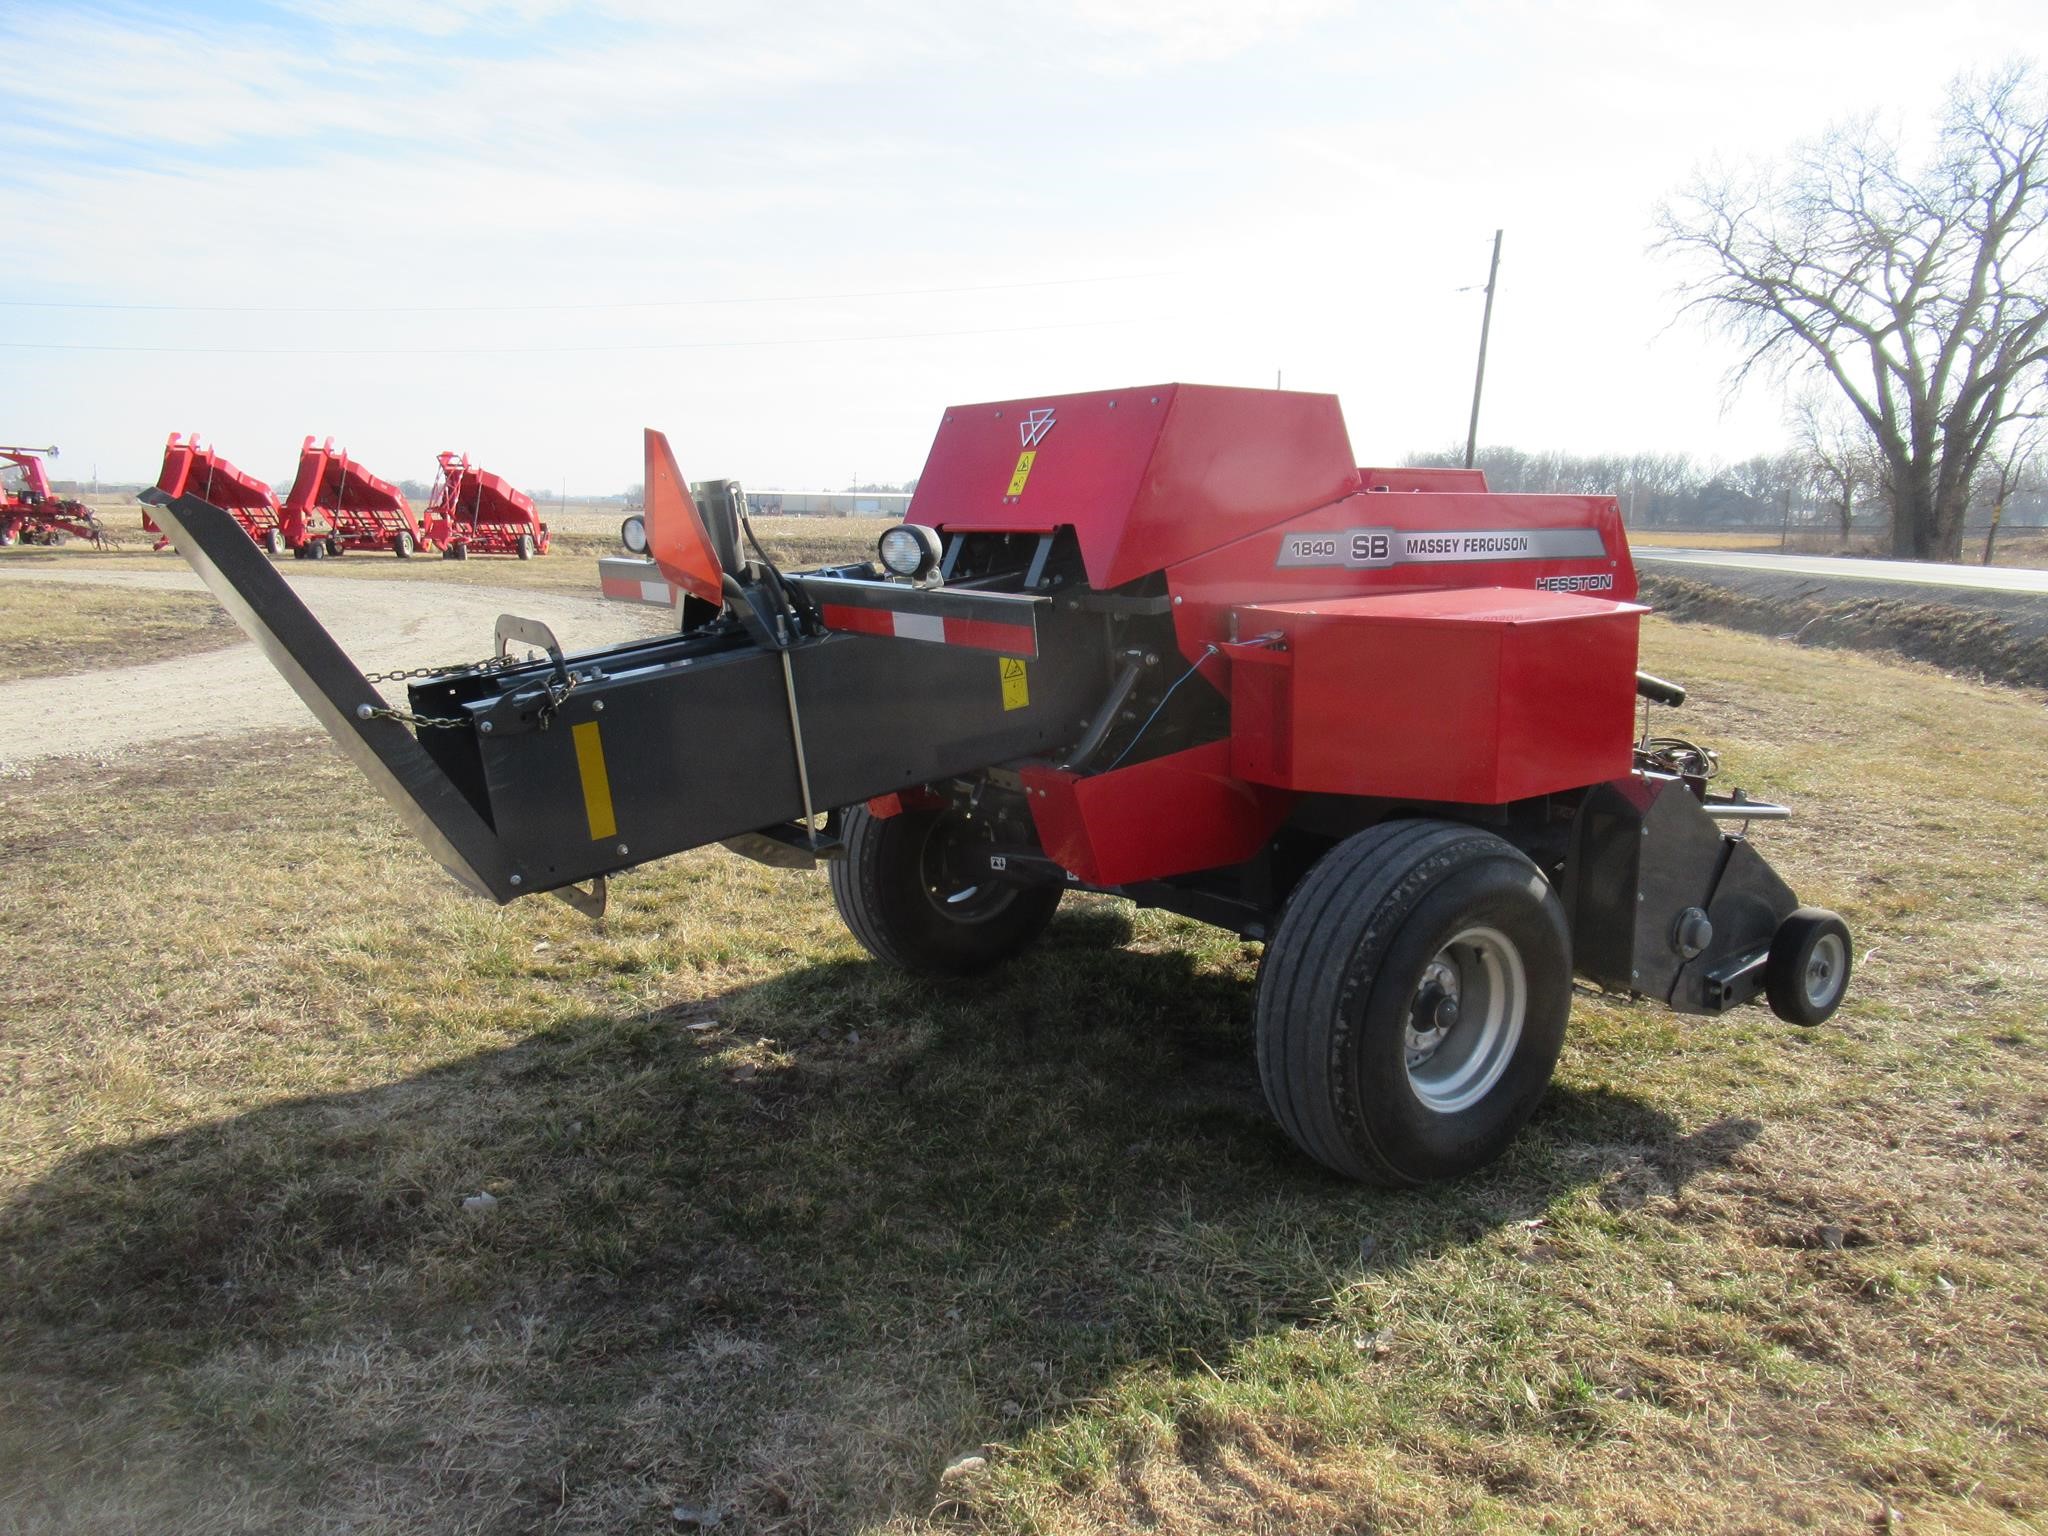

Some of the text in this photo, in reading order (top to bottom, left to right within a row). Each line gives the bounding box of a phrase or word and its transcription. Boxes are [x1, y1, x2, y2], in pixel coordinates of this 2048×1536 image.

[1291, 534, 1528, 560] 1840 SB MASSEY FERGUSON
[1536, 574, 1613, 592] HESSTON
